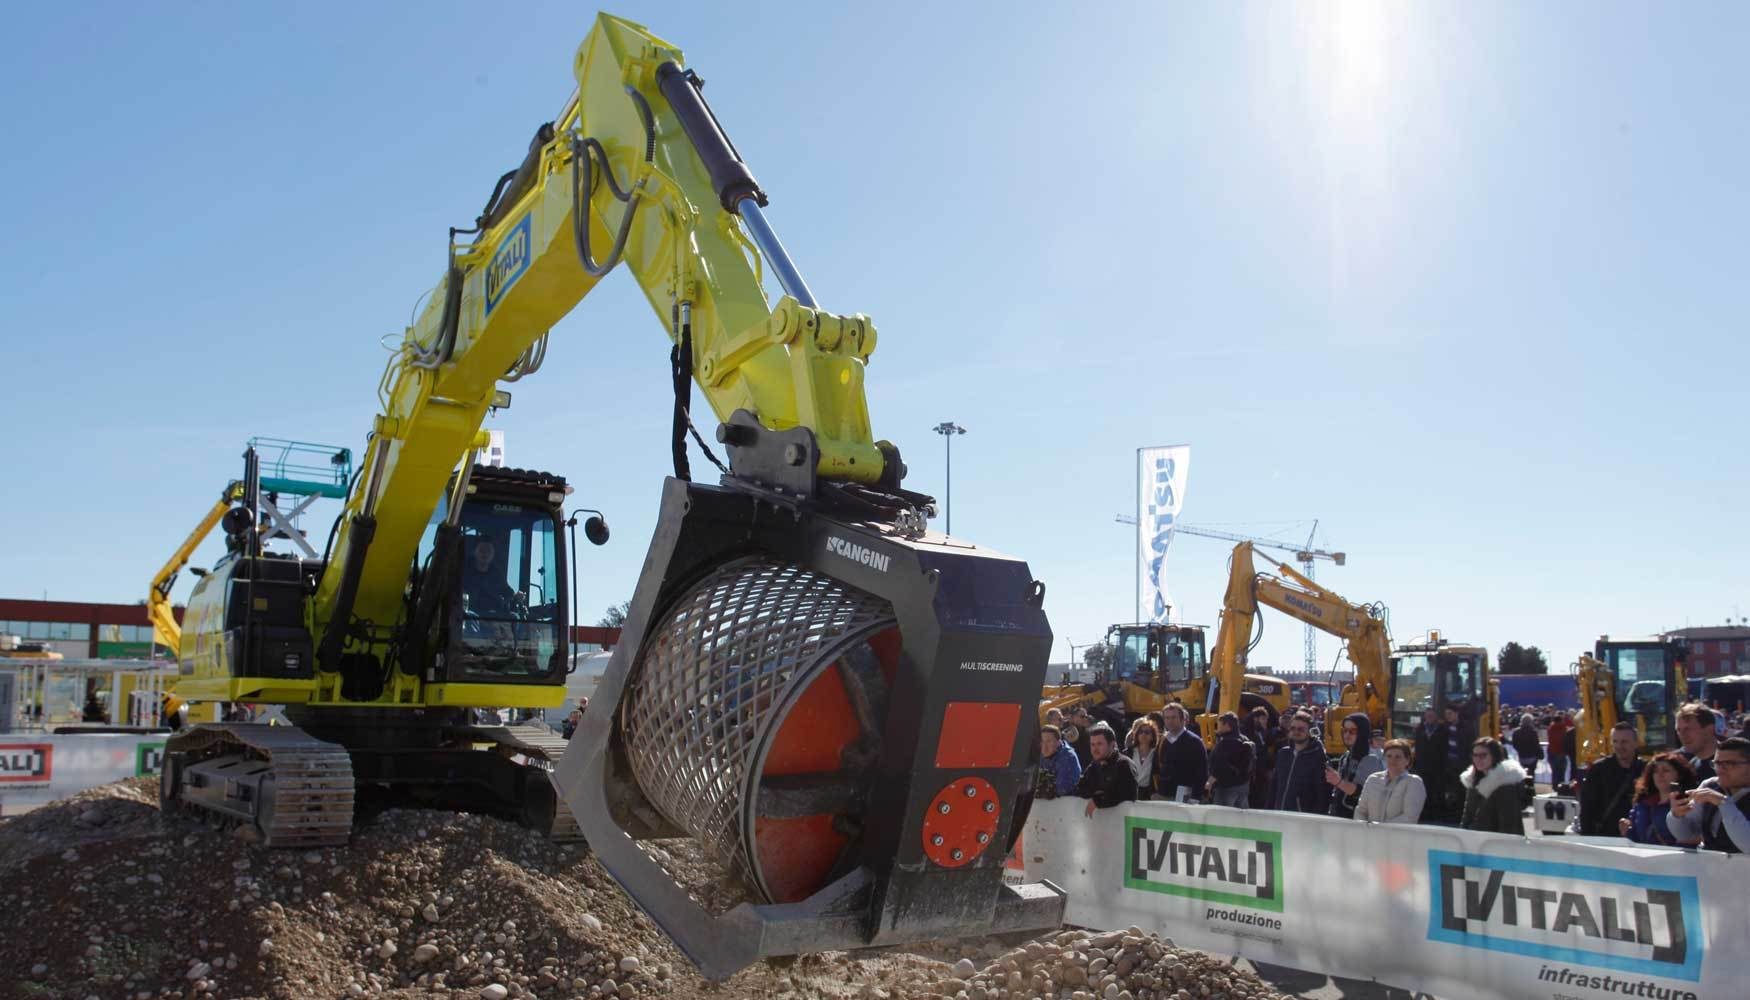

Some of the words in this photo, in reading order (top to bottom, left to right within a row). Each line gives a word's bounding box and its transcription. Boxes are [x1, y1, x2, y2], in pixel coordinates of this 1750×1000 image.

[837, 539, 889, 572] CANGINI
[1284, 592, 1323, 617] KOMATSU
[1206, 907, 1282, 930] produzione
[1538, 965, 1697, 1000] infrastrutture
